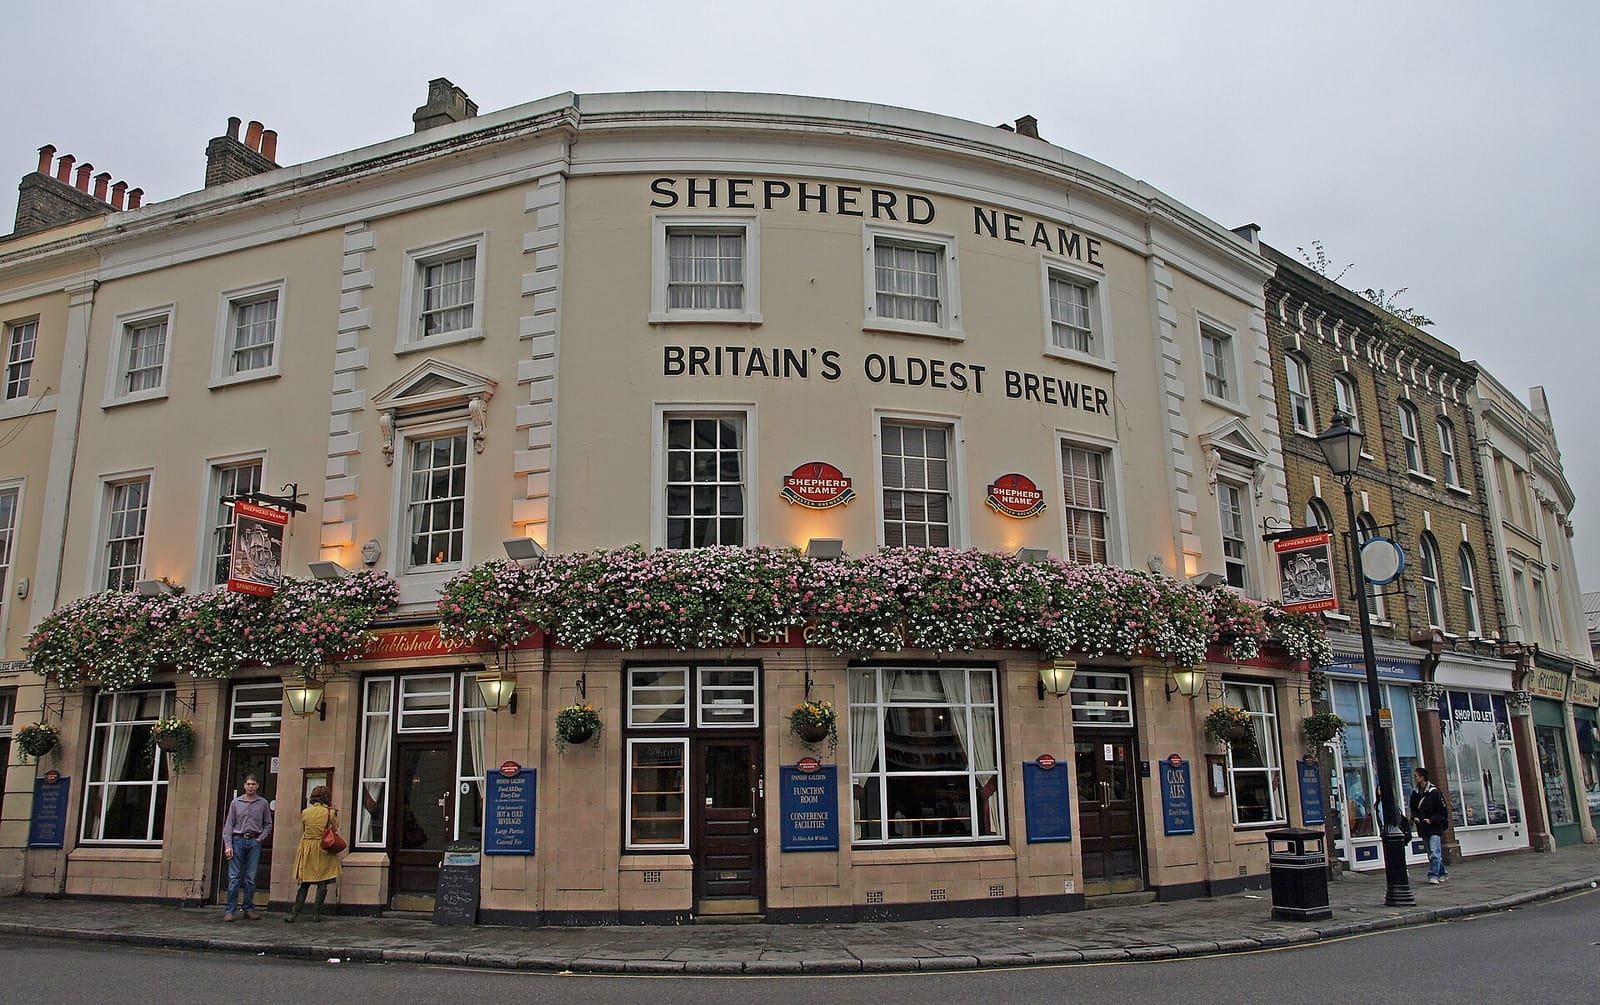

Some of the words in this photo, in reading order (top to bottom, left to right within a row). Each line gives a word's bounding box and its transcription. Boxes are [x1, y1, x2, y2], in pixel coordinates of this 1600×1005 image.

[650, 177, 936, 225] SHEPHERD
[974, 206, 1105, 269] NEAME
[663, 346, 842, 381] BRITAIN'S
[864, 353, 987, 394] OLDEST
[1005, 370, 1109, 416] BREWER
[788, 478, 848, 487] SHEPHERD
[799, 486, 838, 495] NEAME
[993, 487, 1040, 499] SHEPHERD
[1002, 496, 1033, 505] NEAME
[365, 634, 435, 654] Established
[1454, 709, 1471, 720] SHOP
[1472, 710, 1481, 720] TO
[1481, 711, 1493, 721] LET
[1167, 770, 1185, 783] CASK
[793, 786, 825, 795] FUNCTION
[1170, 785, 1185, 798] ALES
[800, 795, 818, 803] ROOM
[790, 812, 828, 820] CONFERENCE
[795, 821, 825, 829] FACILITIES
